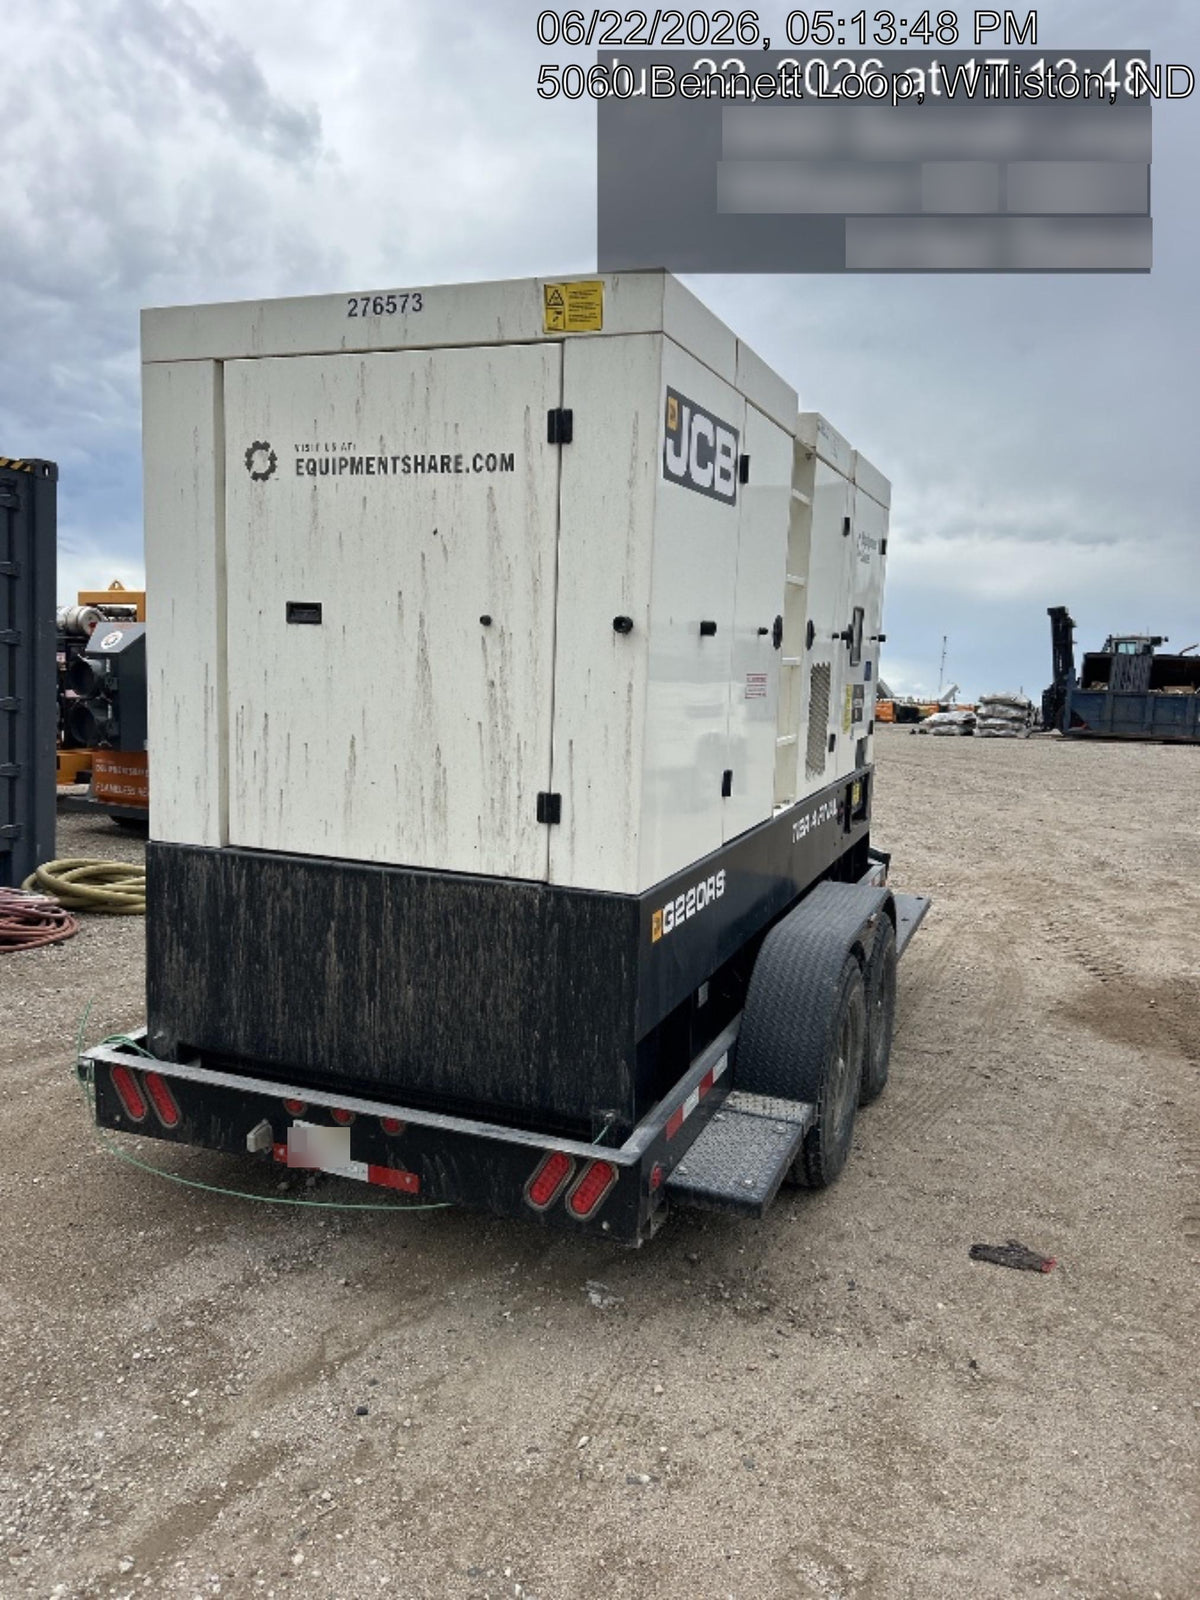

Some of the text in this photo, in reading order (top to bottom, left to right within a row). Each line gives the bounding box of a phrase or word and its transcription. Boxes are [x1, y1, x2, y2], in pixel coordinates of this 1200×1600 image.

[347, 293, 424, 318] 276573
[295, 453, 516, 477] EQUIPMENTSHARE.COM
[666, 405, 737, 497] JCB
[662, 868, 726, 935] G220RS
